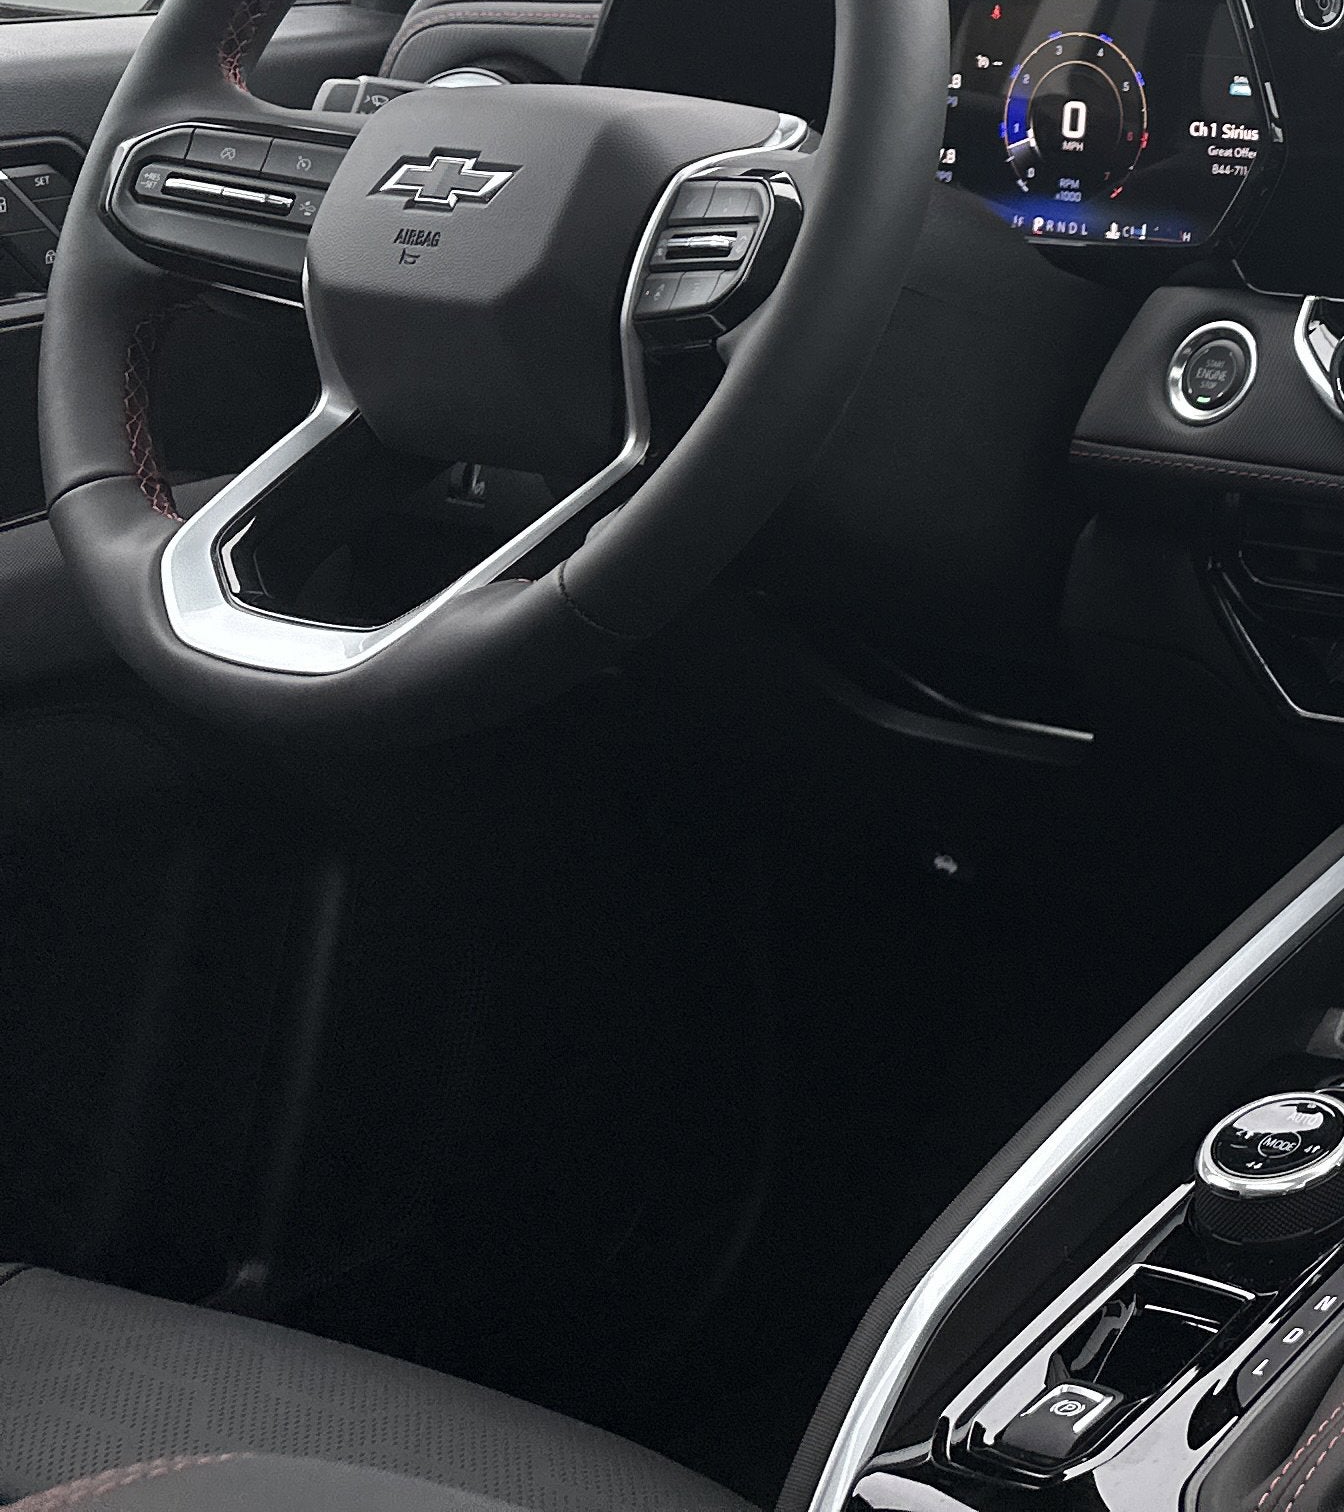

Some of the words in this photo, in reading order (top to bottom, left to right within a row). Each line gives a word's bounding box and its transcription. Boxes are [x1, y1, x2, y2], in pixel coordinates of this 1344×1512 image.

[1056, 45, 1063, 56] 3
[1023, 74, 1030, 85] 2
[1123, 81, 1130, 92] 5
[1062, 101, 1087, 139] 0
[1013, 122, 1020, 134] 1
[1189, 121, 1208, 138] Ch
[1210, 122, 1217, 138] 1
[1221, 123, 1260, 141] Sirius
[1062, 140, 1084, 152] MPH
[1207, 145, 1234, 158] Great
[34, 175, 50, 188] SET
[1059, 178, 1080, 190] RPM
[1046, 220, 1055, 232] R
[1057, 221, 1066, 233] N
[1068, 221, 1078, 235] D
[1081, 223, 1088, 236] L
[393, 228, 441, 248] AIRBAG
[1196, 367, 1227, 382] ENGINE
[1287, 1113, 1318, 1126] AUTO
[1263, 1137, 1298, 1152] MODE
[1313, 1295, 1338, 1311] N
[1282, 1327, 1304, 1343] D
[1251, 1358, 1270, 1376] L
